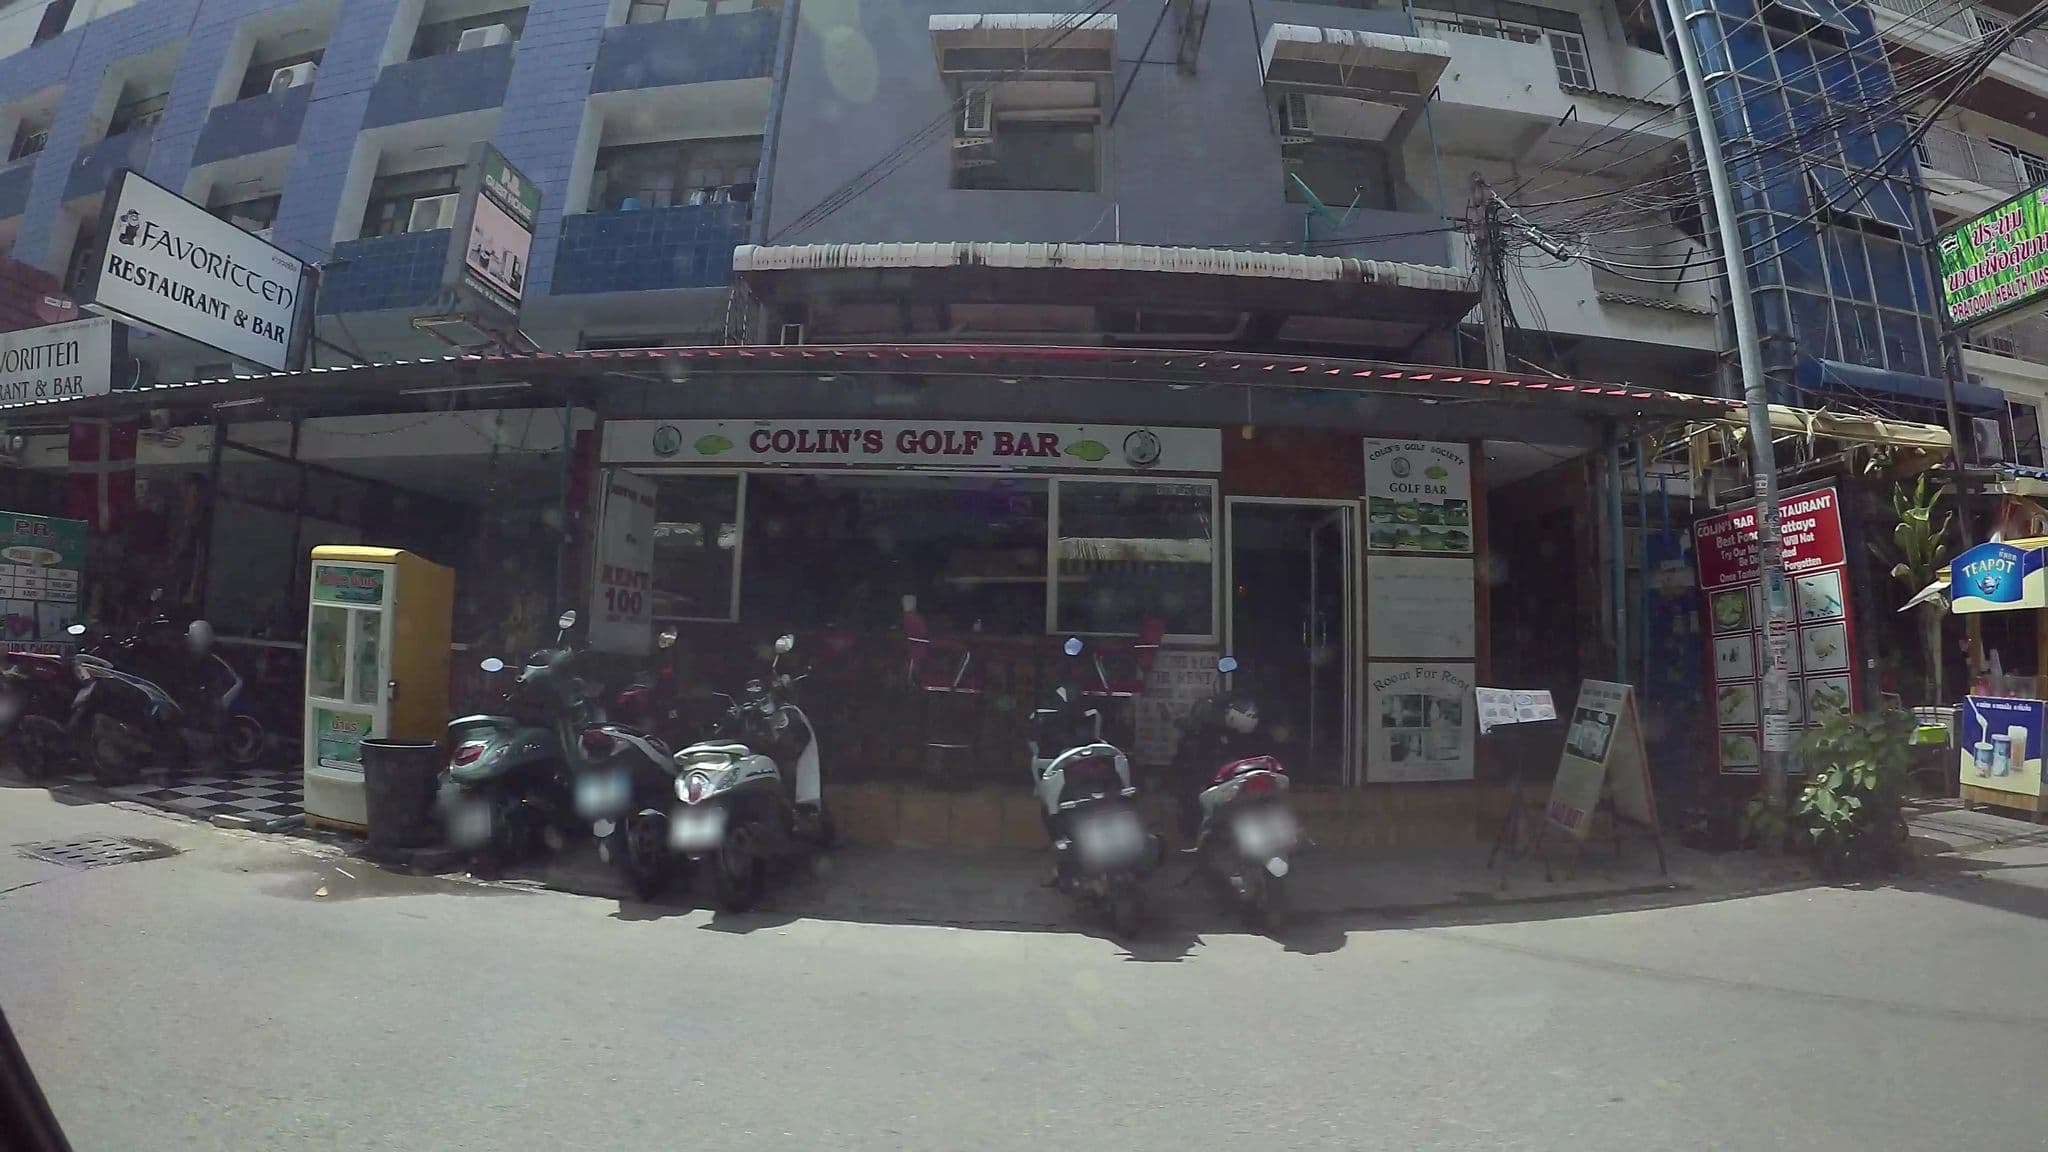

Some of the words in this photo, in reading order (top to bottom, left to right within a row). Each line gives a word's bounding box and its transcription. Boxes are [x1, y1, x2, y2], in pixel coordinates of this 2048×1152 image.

[107, 254, 230, 320] RESTAURANT
[233, 309, 248, 328] &
[252, 316, 284, 344] BAR
[1952, 292, 1992, 317] PRATOOM
[1994, 275, 2029, 303] HEALTH
[35, 380, 47, 397] &
[54, 375, 83, 396] BAR
[749, 429, 883, 454] COLIN'S
[896, 430, 983, 455] GOLF
[993, 432, 1061, 457] BAR
[1389, 482, 1420, 494] GOLF
[1424, 484, 1447, 495] BAR
[1733, 515, 1755, 529] BAR
[1784, 557, 1822, 572] Forgotten
[1961, 558, 2016, 578] TEAPOT
[605, 587, 643, 614] 100
[1373, 671, 1411, 692] Room
[1415, 666, 1438, 679] For
